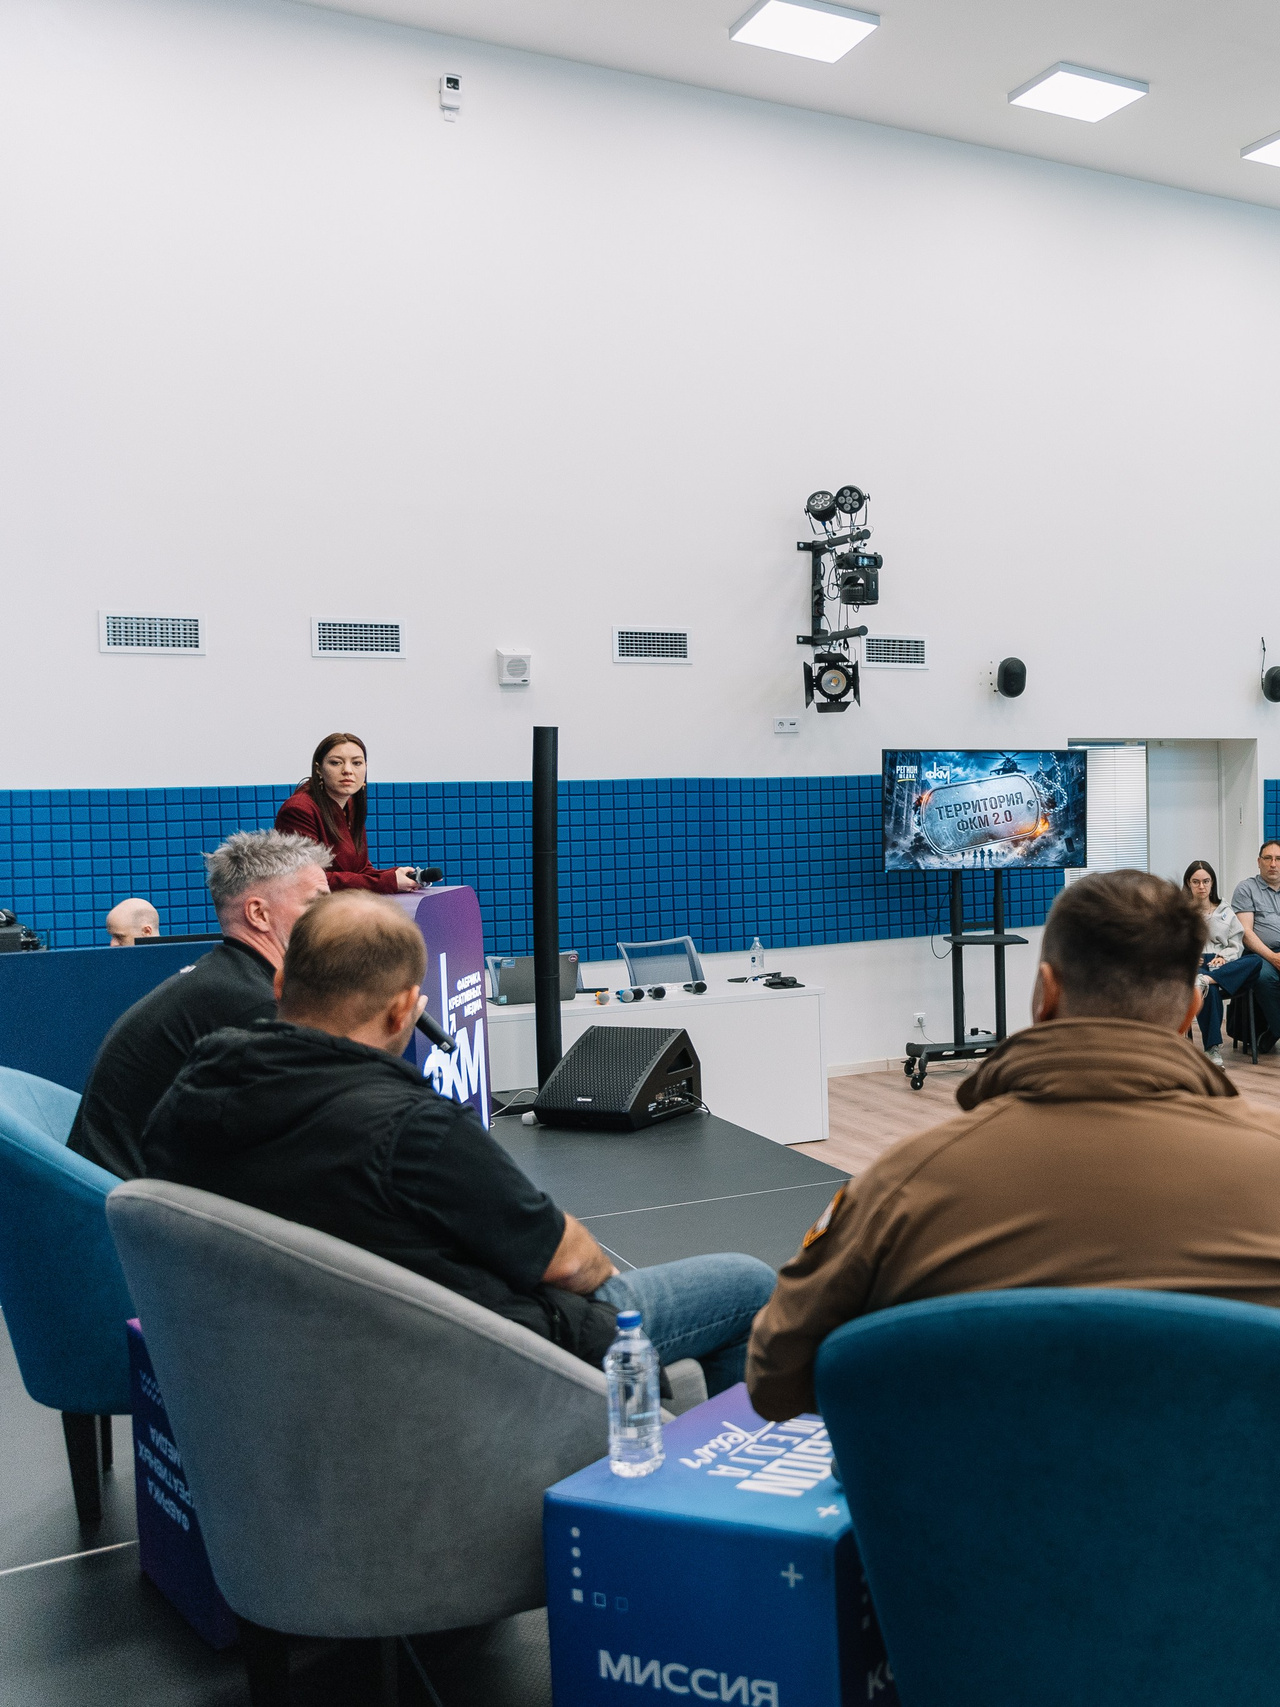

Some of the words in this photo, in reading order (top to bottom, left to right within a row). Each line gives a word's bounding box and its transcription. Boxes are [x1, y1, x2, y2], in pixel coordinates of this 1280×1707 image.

[896, 765, 918, 774] РЕГИОН
[935, 791, 1024, 821] ТЕРРИТОРИЯ
[956, 815, 990, 833] ФКМ
[993, 809, 1013, 826] 2.0
[456, 970, 482, 992] ФАБРИКА
[448, 984, 482, 1011] КРЕАТИВНЫХ
[464, 998, 483, 1018] МЕДИА
[599, 1648, 780, 1707] МИССИЯ
